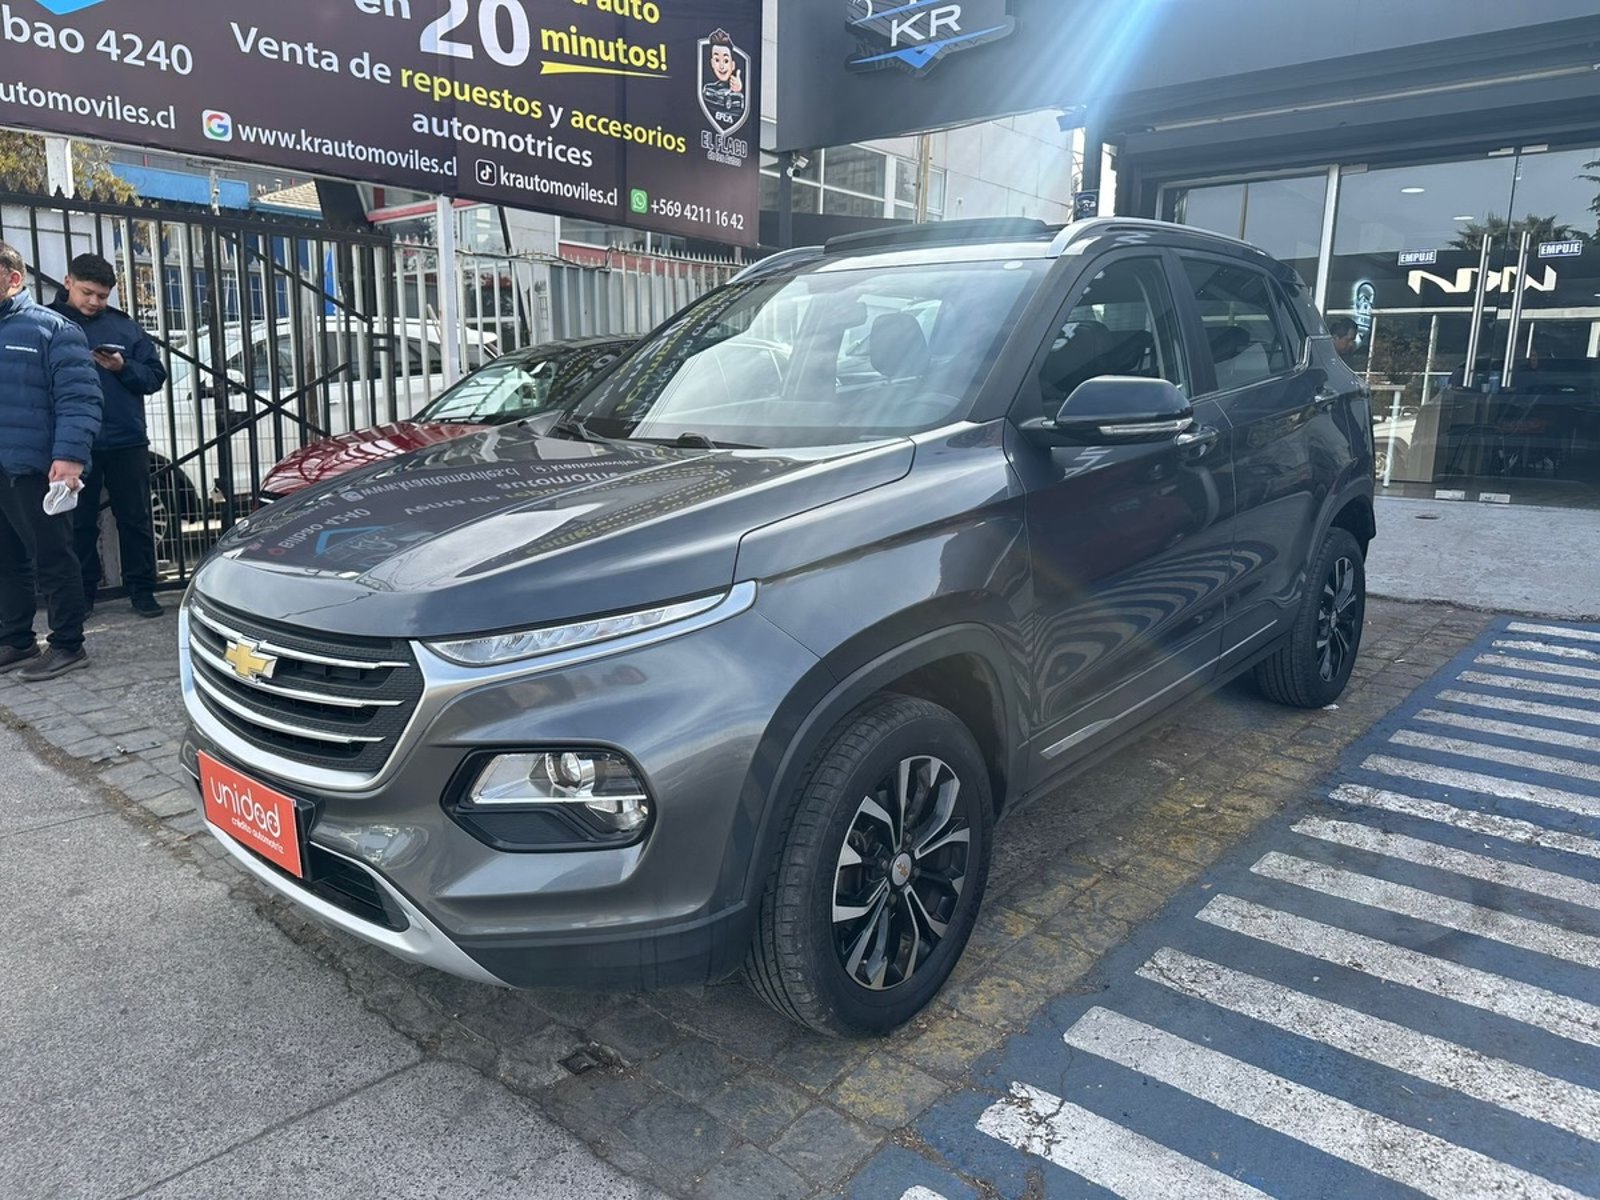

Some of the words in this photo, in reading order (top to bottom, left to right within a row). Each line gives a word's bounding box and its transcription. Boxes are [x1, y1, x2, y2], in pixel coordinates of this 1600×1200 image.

[2, 3, 85, 54] bao
[96, 29, 193, 75] 4240
[419, 0, 531, 67] 20
[540, 25, 668, 71] minutos!
[890, 4, 962, 48] KR
[0, 81, 176, 129] utomoviles.cl
[230, 22, 340, 73] Venta
[349, 51, 392, 84] de
[400, 68, 543, 119] repuestos
[548, 104, 564, 128] y
[570, 109, 687, 153] accesorios
[237, 123, 457, 177] www.krautomoviles.cl
[412, 112, 593, 168] automotrices
[500, 165, 618, 206] krautomoviles.cl
[651, 198, 681, 218] +569
[683, 203, 711, 224] 4211
[1400, 251, 1436, 263] EMPUJE
[1540, 242, 1581, 255] EMPUJE
[210, 776, 281, 838] unidad
